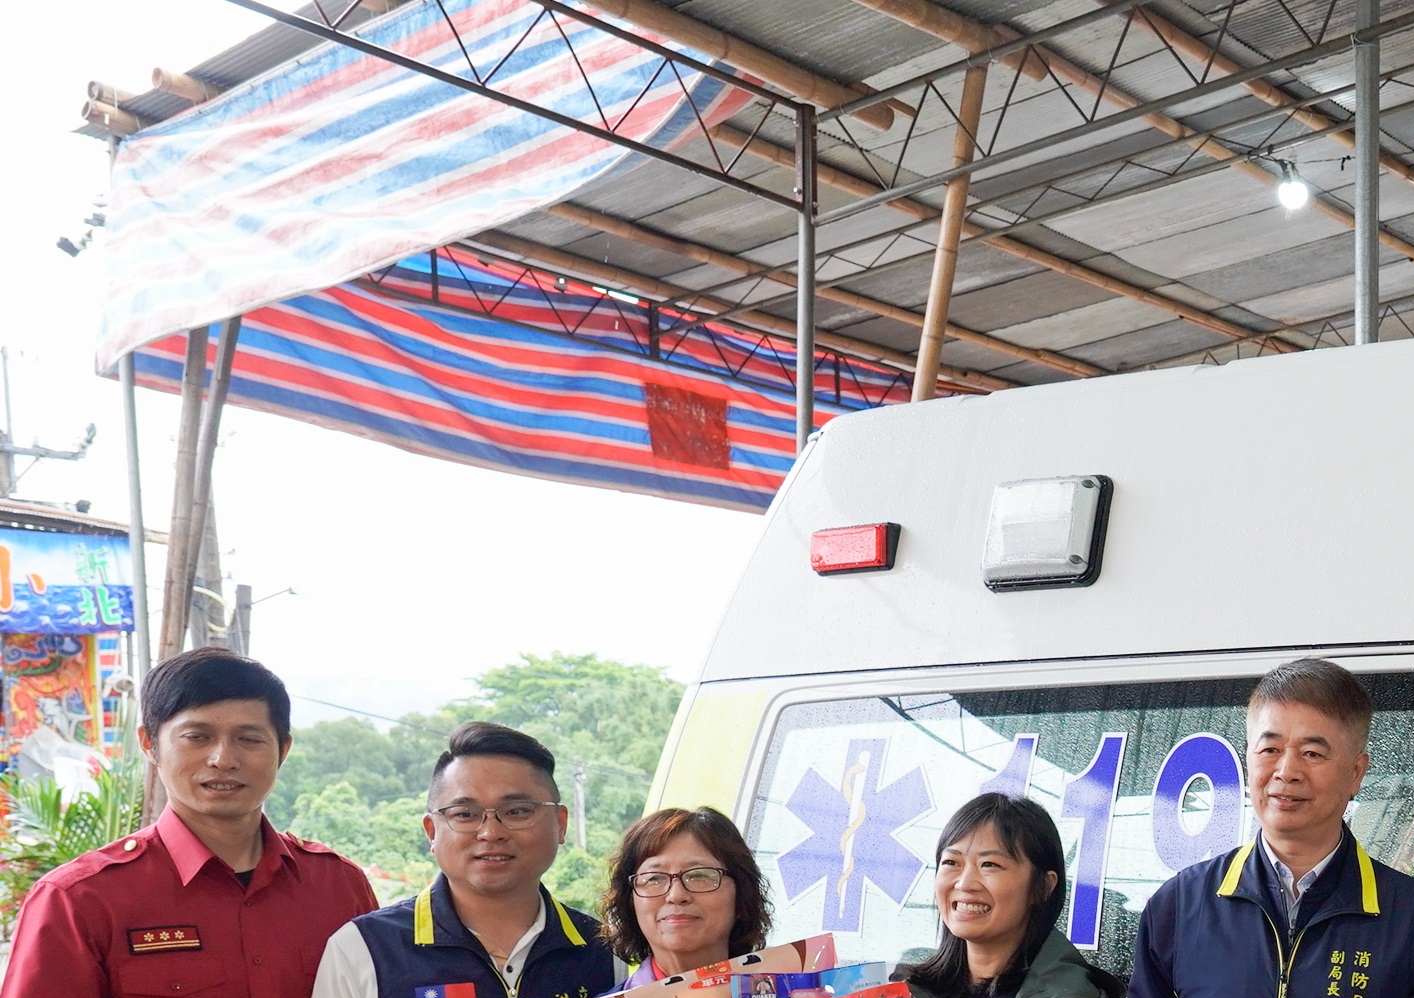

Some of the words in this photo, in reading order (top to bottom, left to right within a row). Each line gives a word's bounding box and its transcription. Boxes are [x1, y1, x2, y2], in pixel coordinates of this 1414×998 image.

[76, 543, 122, 626] 新北
[980, 731, 1245, 951] 19
[1328, 950, 1346, 997] 副局長
